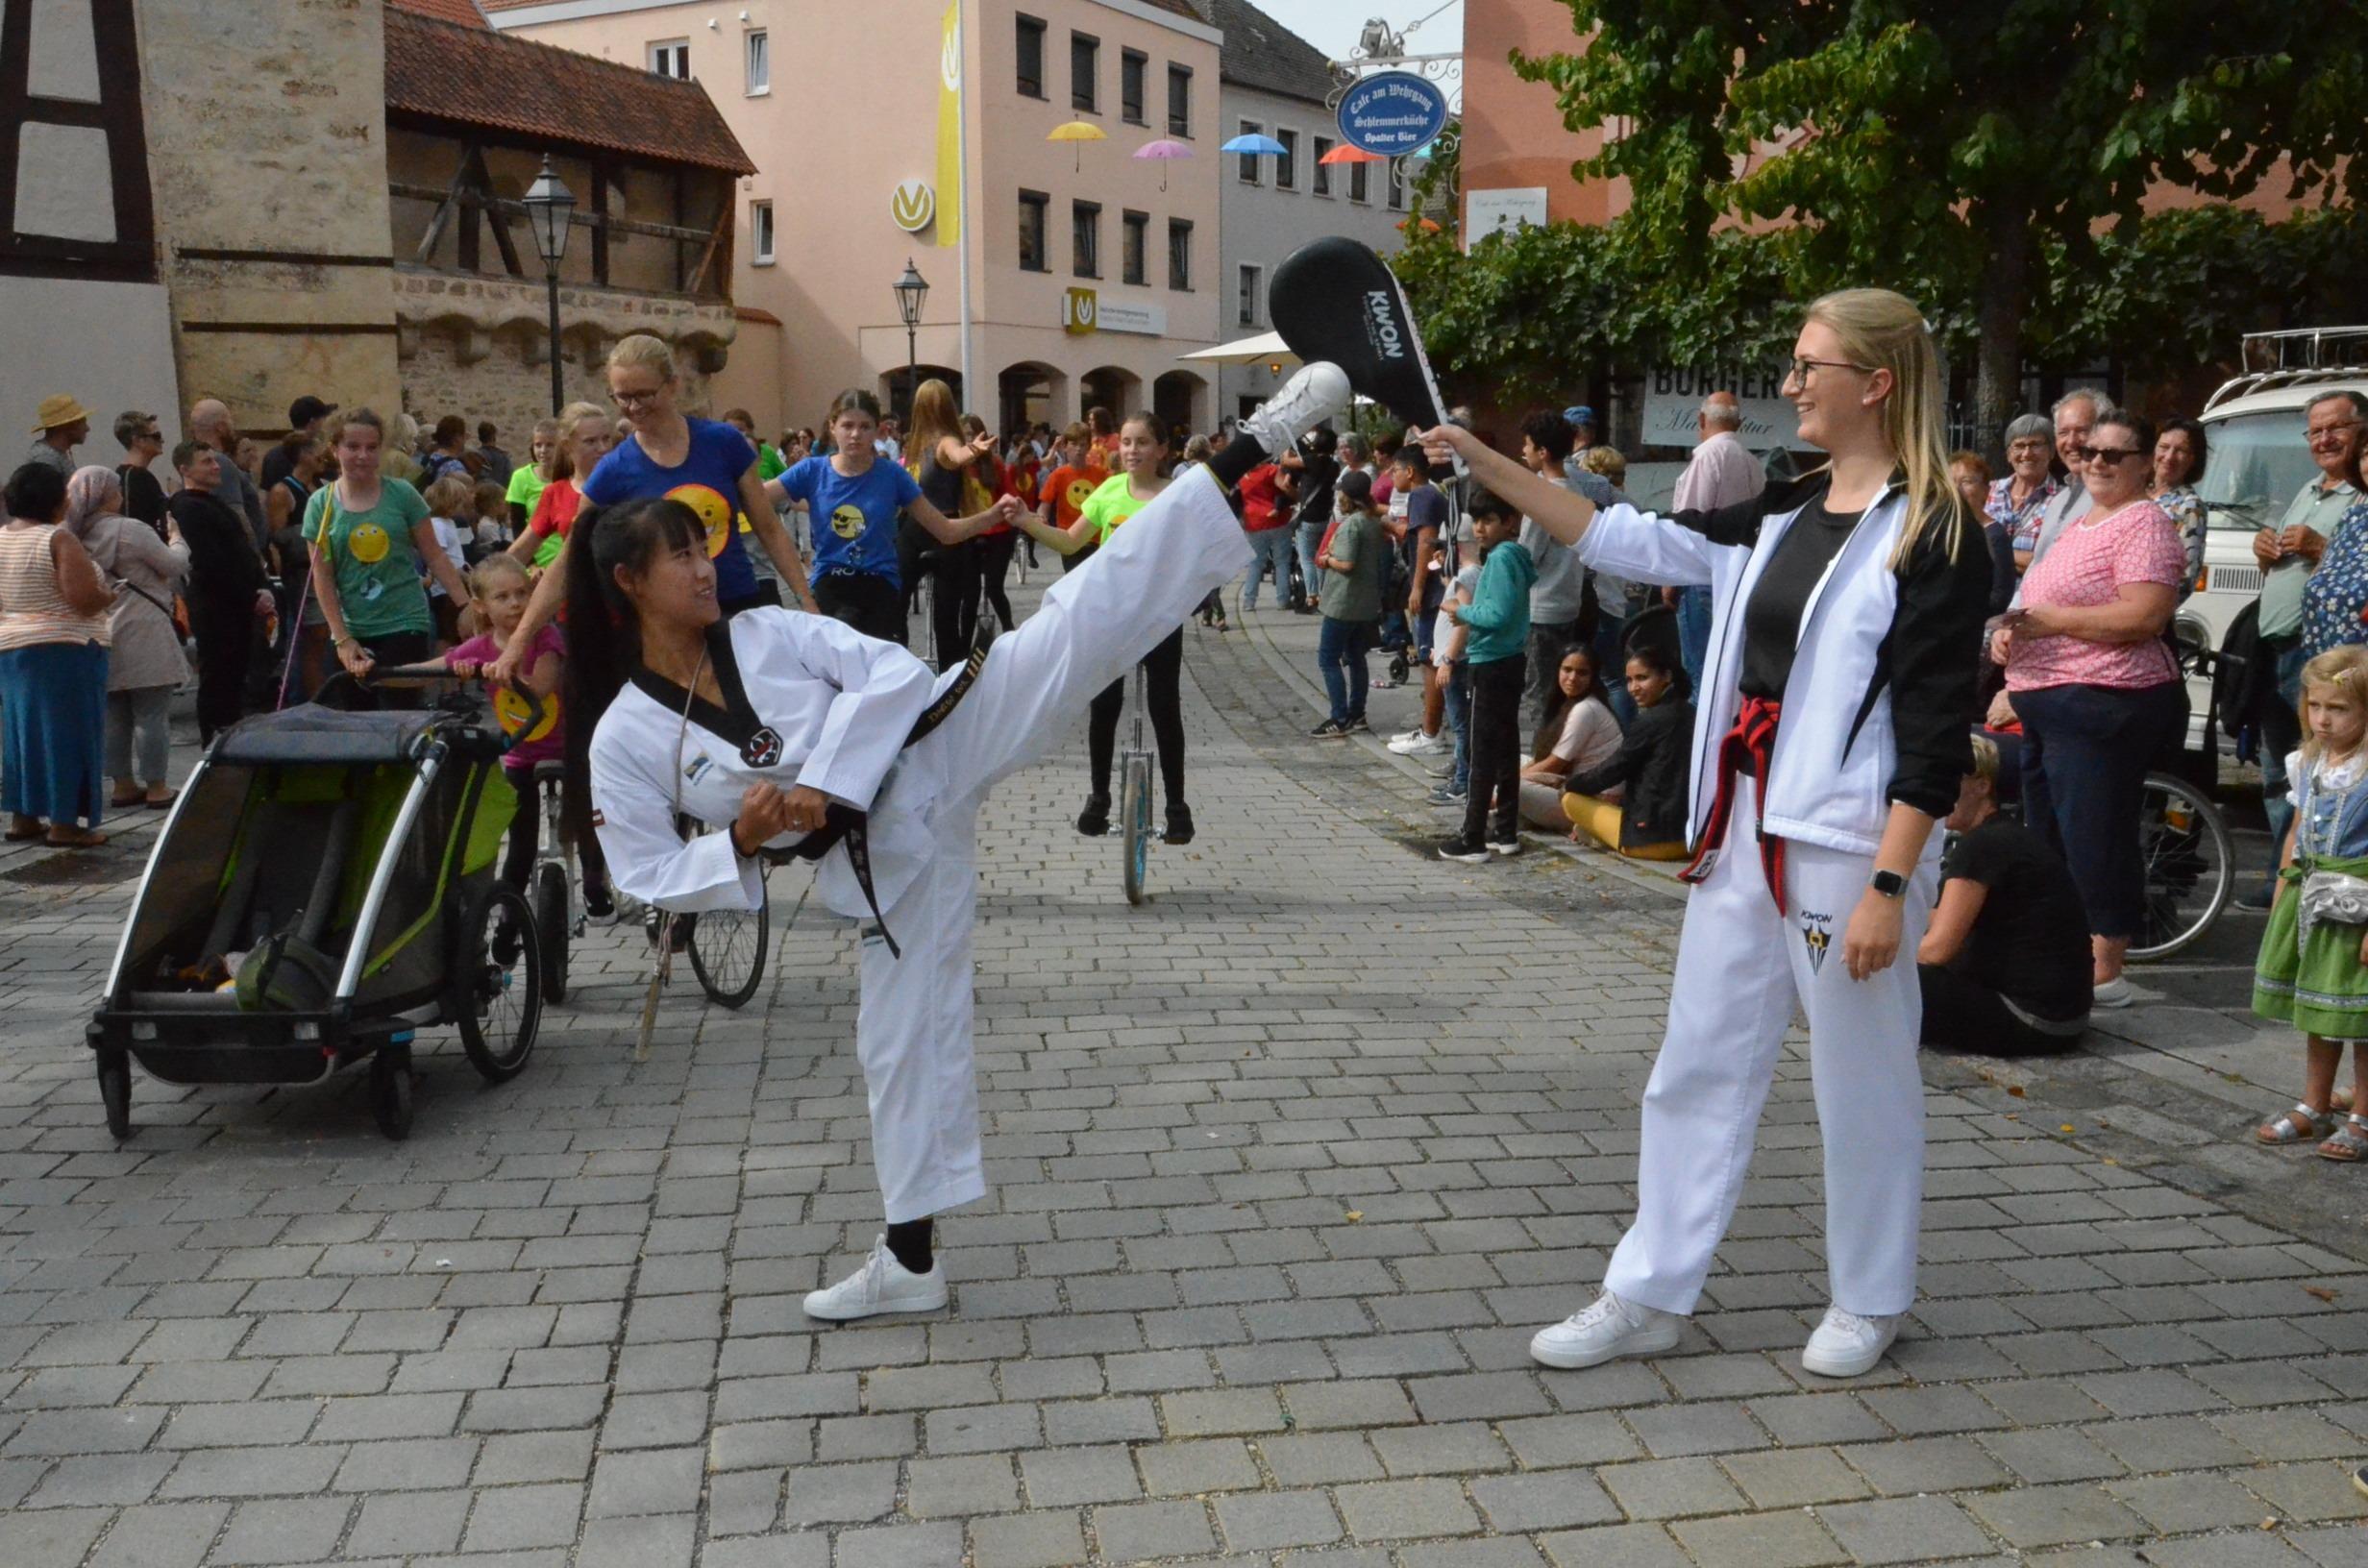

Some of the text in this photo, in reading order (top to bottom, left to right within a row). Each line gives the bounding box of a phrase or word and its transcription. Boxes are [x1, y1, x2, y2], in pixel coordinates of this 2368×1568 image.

[1371, 87, 1386, 99] am
[1368, 291, 1403, 357] KWON
[1656, 407, 1773, 434] Maktur
[1801, 909, 1833, 923] KWON
